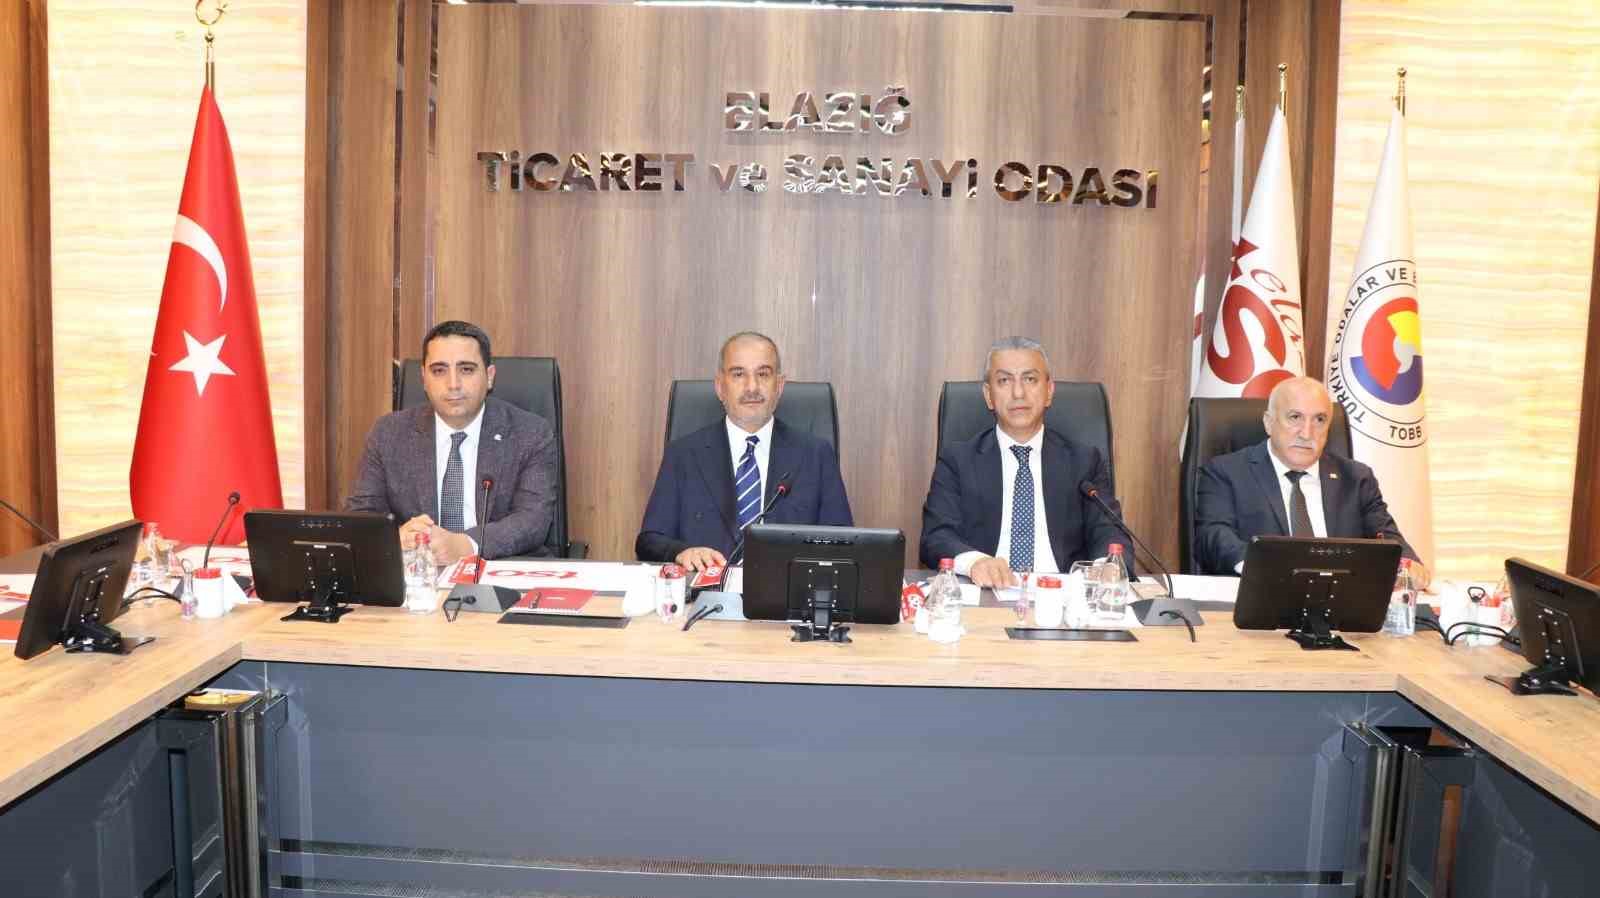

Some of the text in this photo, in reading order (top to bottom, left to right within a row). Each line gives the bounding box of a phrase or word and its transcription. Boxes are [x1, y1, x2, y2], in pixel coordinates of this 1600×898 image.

[710, 162, 769, 193] ve
[993, 161, 1158, 208] ODASI
[1386, 267, 1407, 281] VE
[1390, 425, 1422, 440] TOBB
